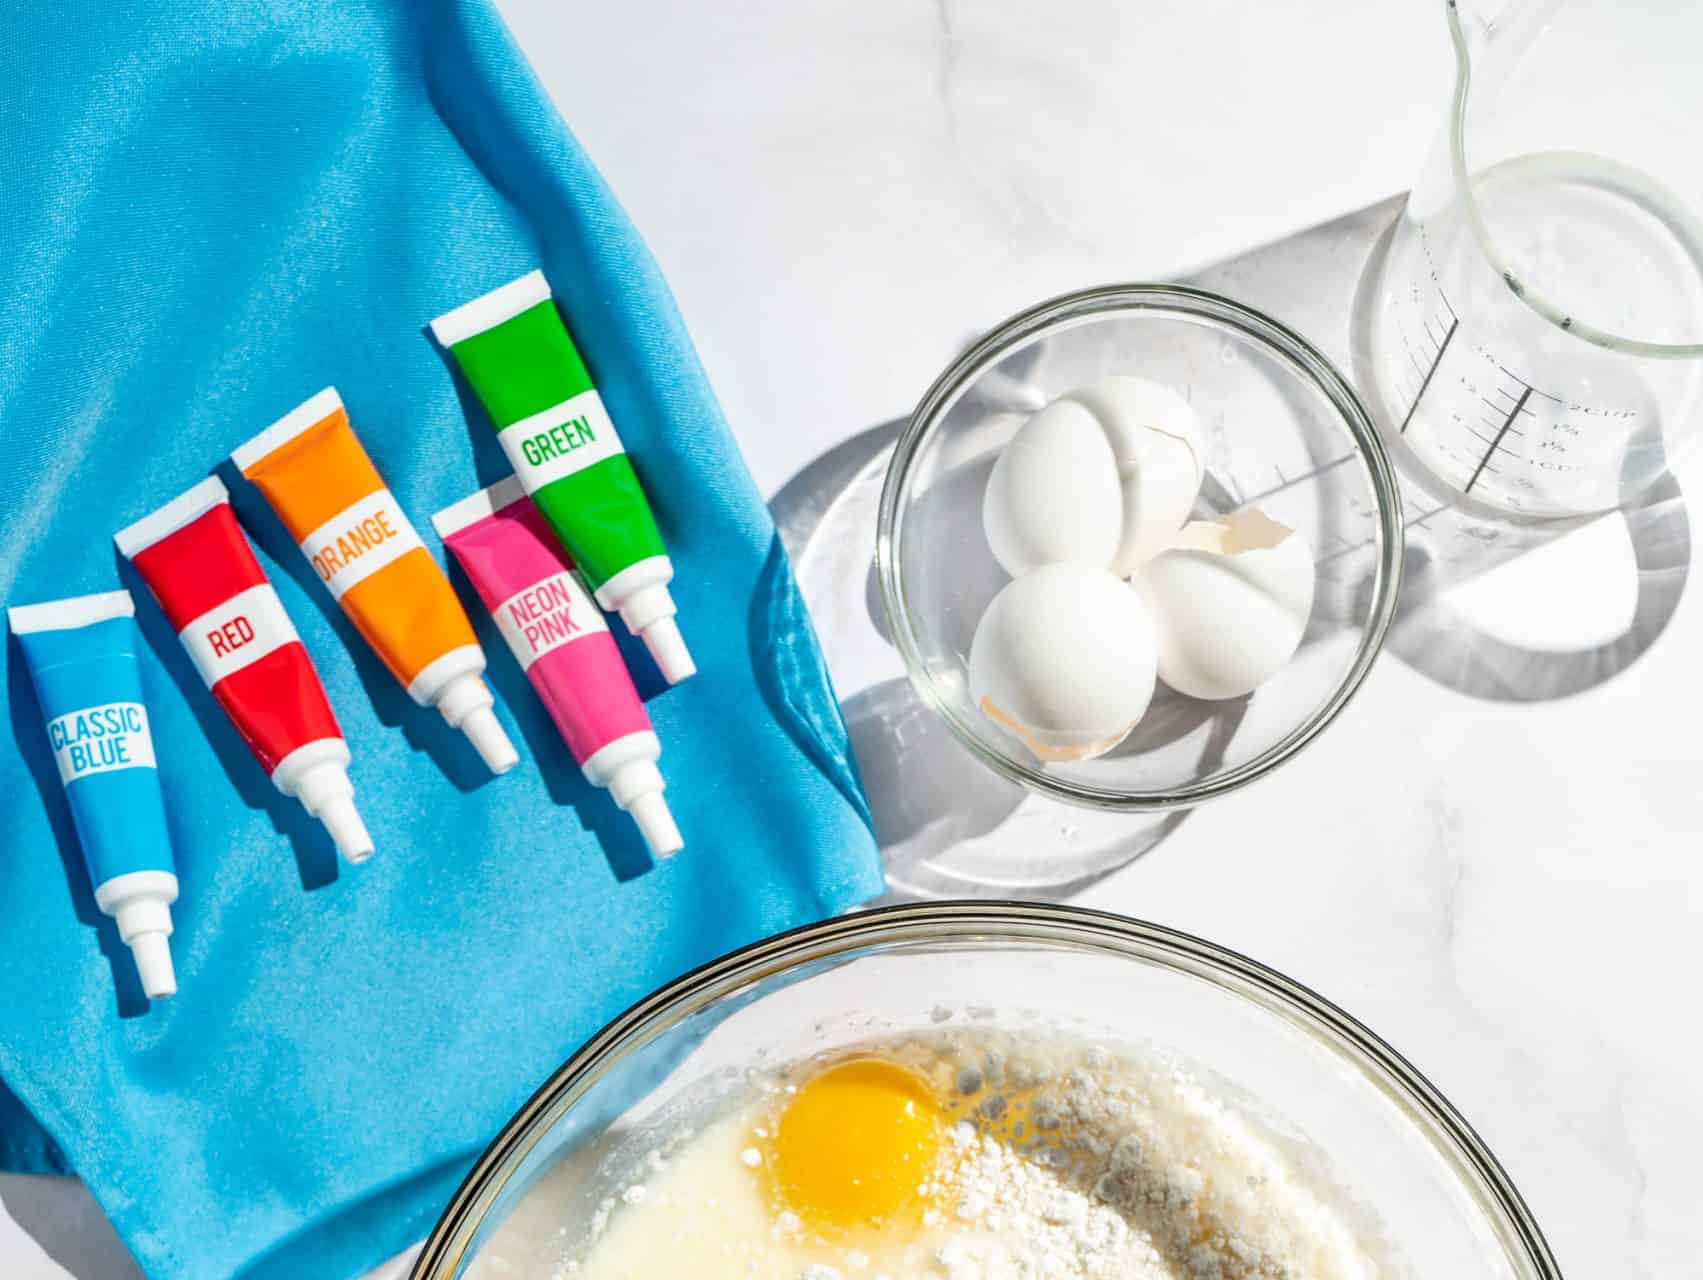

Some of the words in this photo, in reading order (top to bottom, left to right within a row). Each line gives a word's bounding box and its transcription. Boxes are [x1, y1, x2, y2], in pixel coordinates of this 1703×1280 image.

[521, 416, 597, 457] GREEN
[312, 510, 397, 581] ORANGE
[508, 578, 571, 629] NEON
[206, 615, 255, 658] RED
[524, 613, 581, 653] PINK
[50, 706, 142, 752] CLASSIC
[69, 737, 130, 772] BLUE
